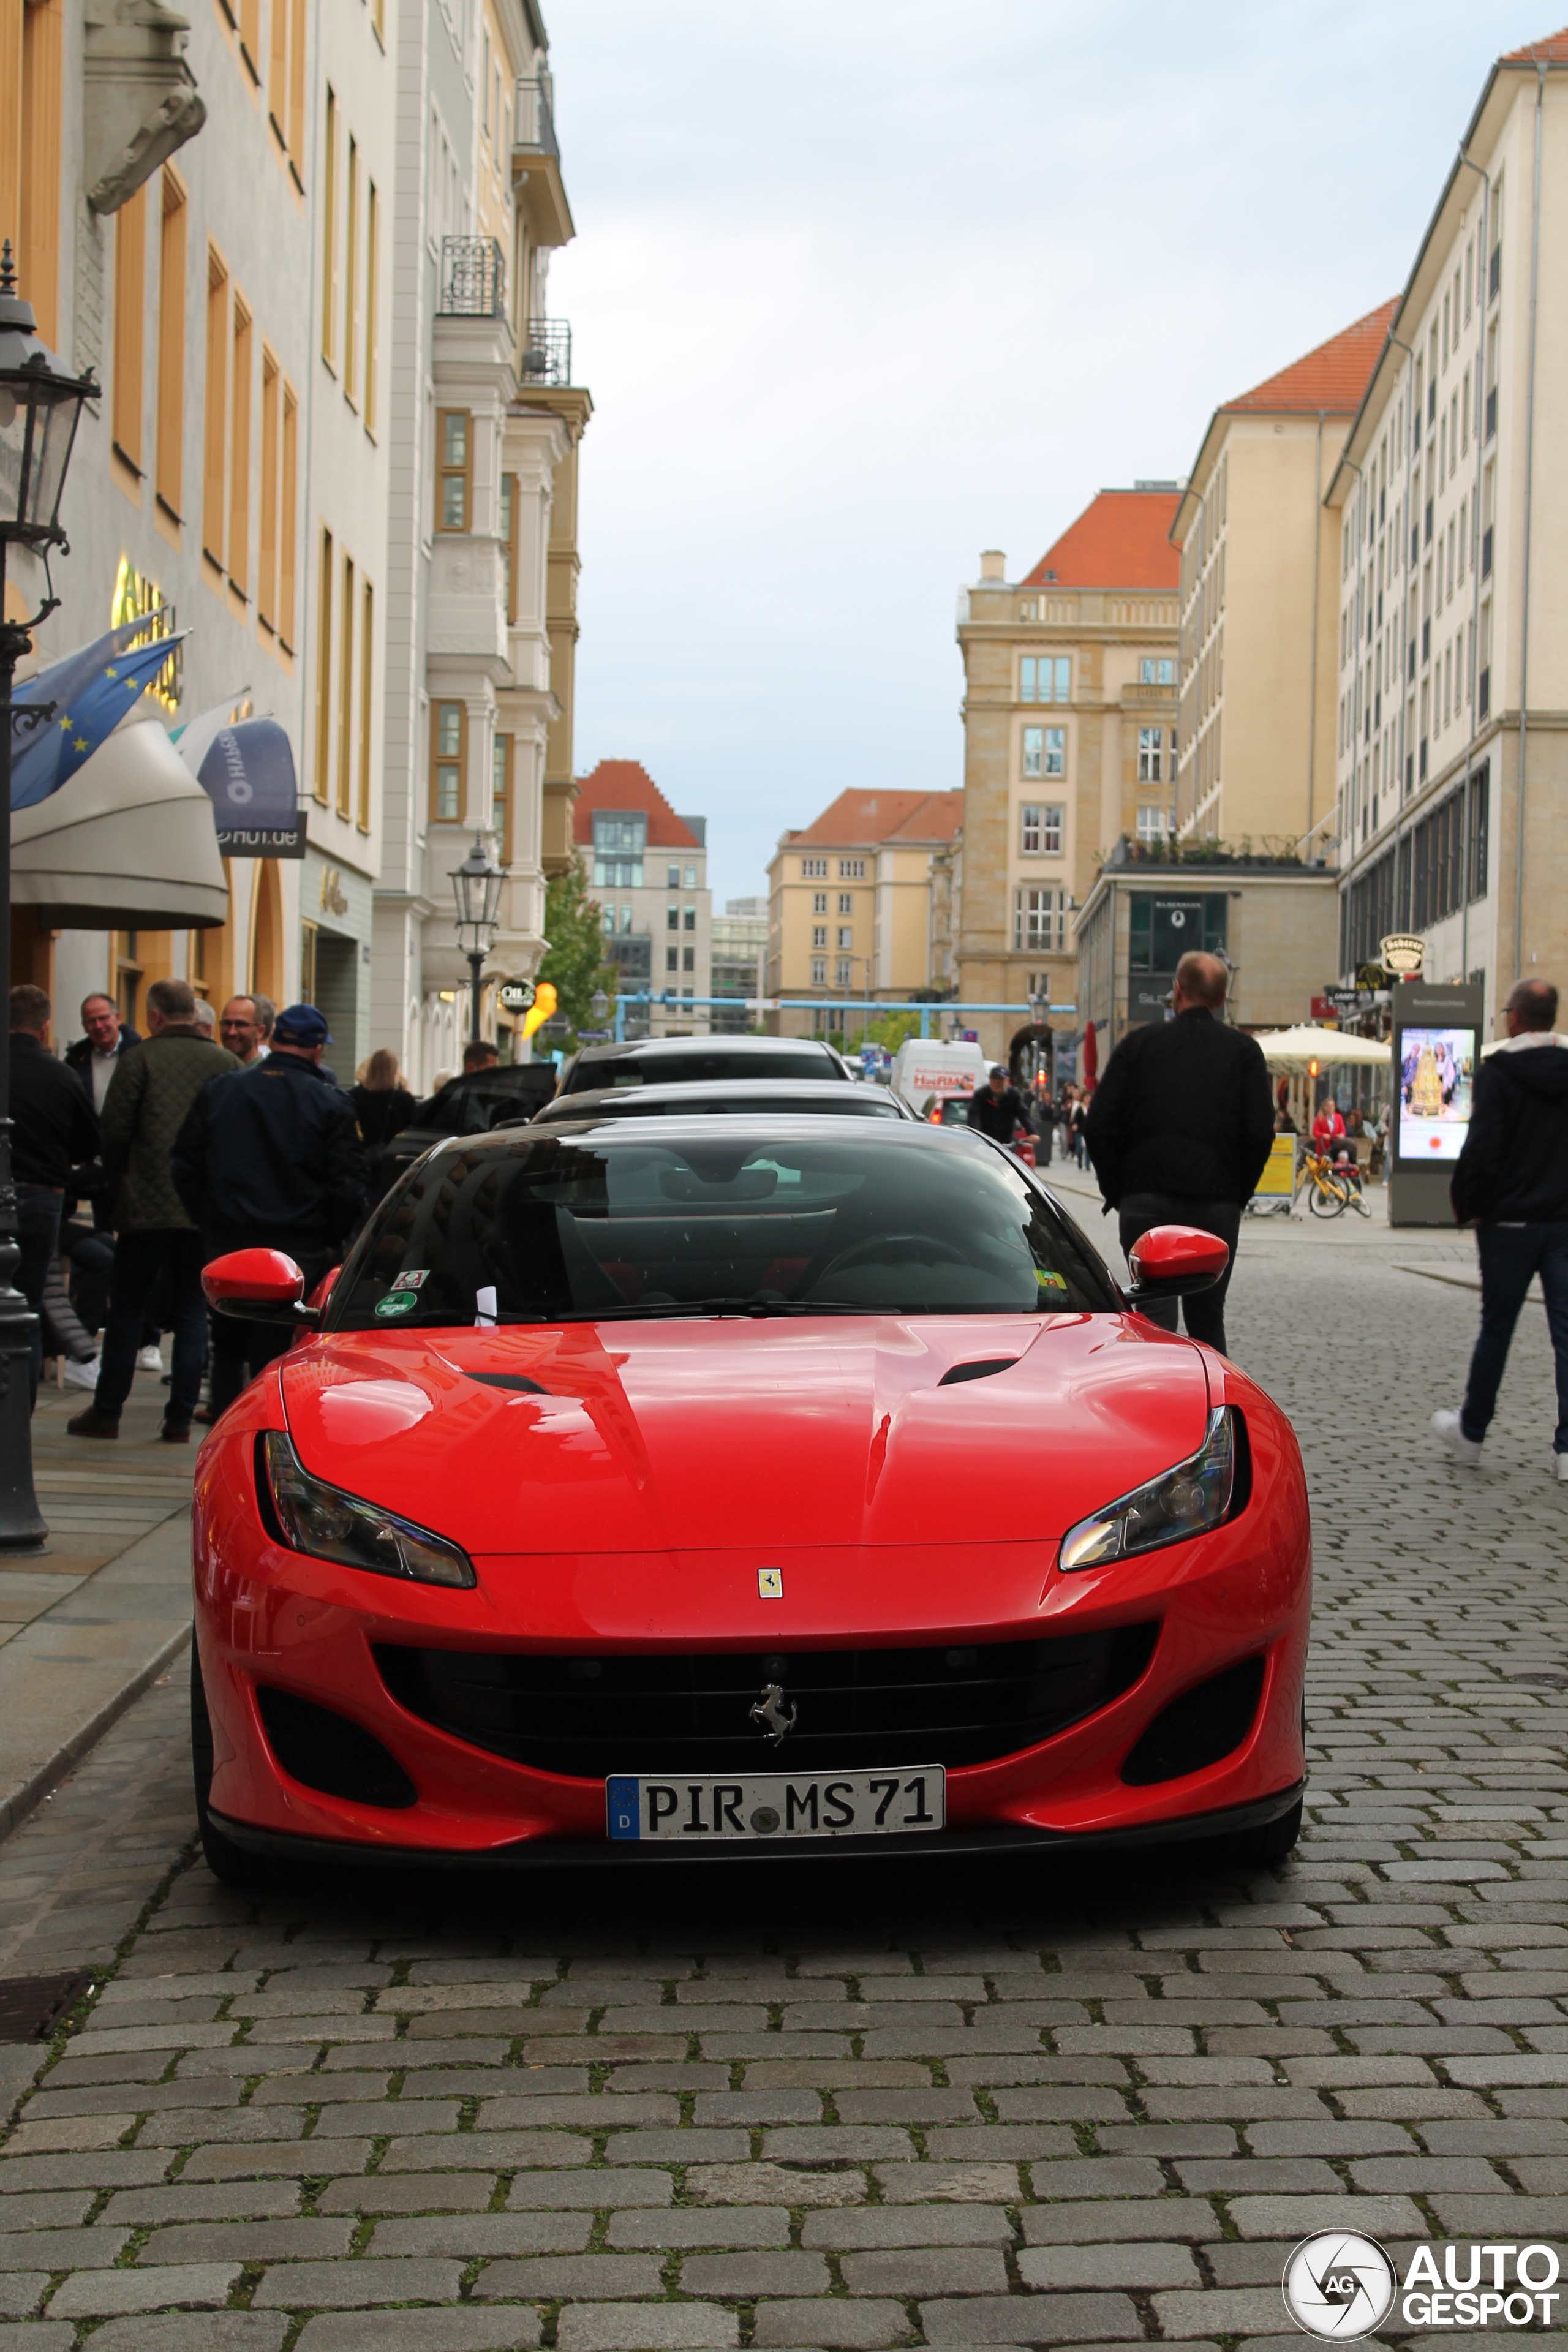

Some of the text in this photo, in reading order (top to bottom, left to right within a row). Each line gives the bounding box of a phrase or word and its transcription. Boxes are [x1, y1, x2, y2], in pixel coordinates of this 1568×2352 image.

[393, 1293, 407, 1304] 4
[646, 1776, 933, 1832] PIR MS 71
[619, 1815, 630, 1828] D
